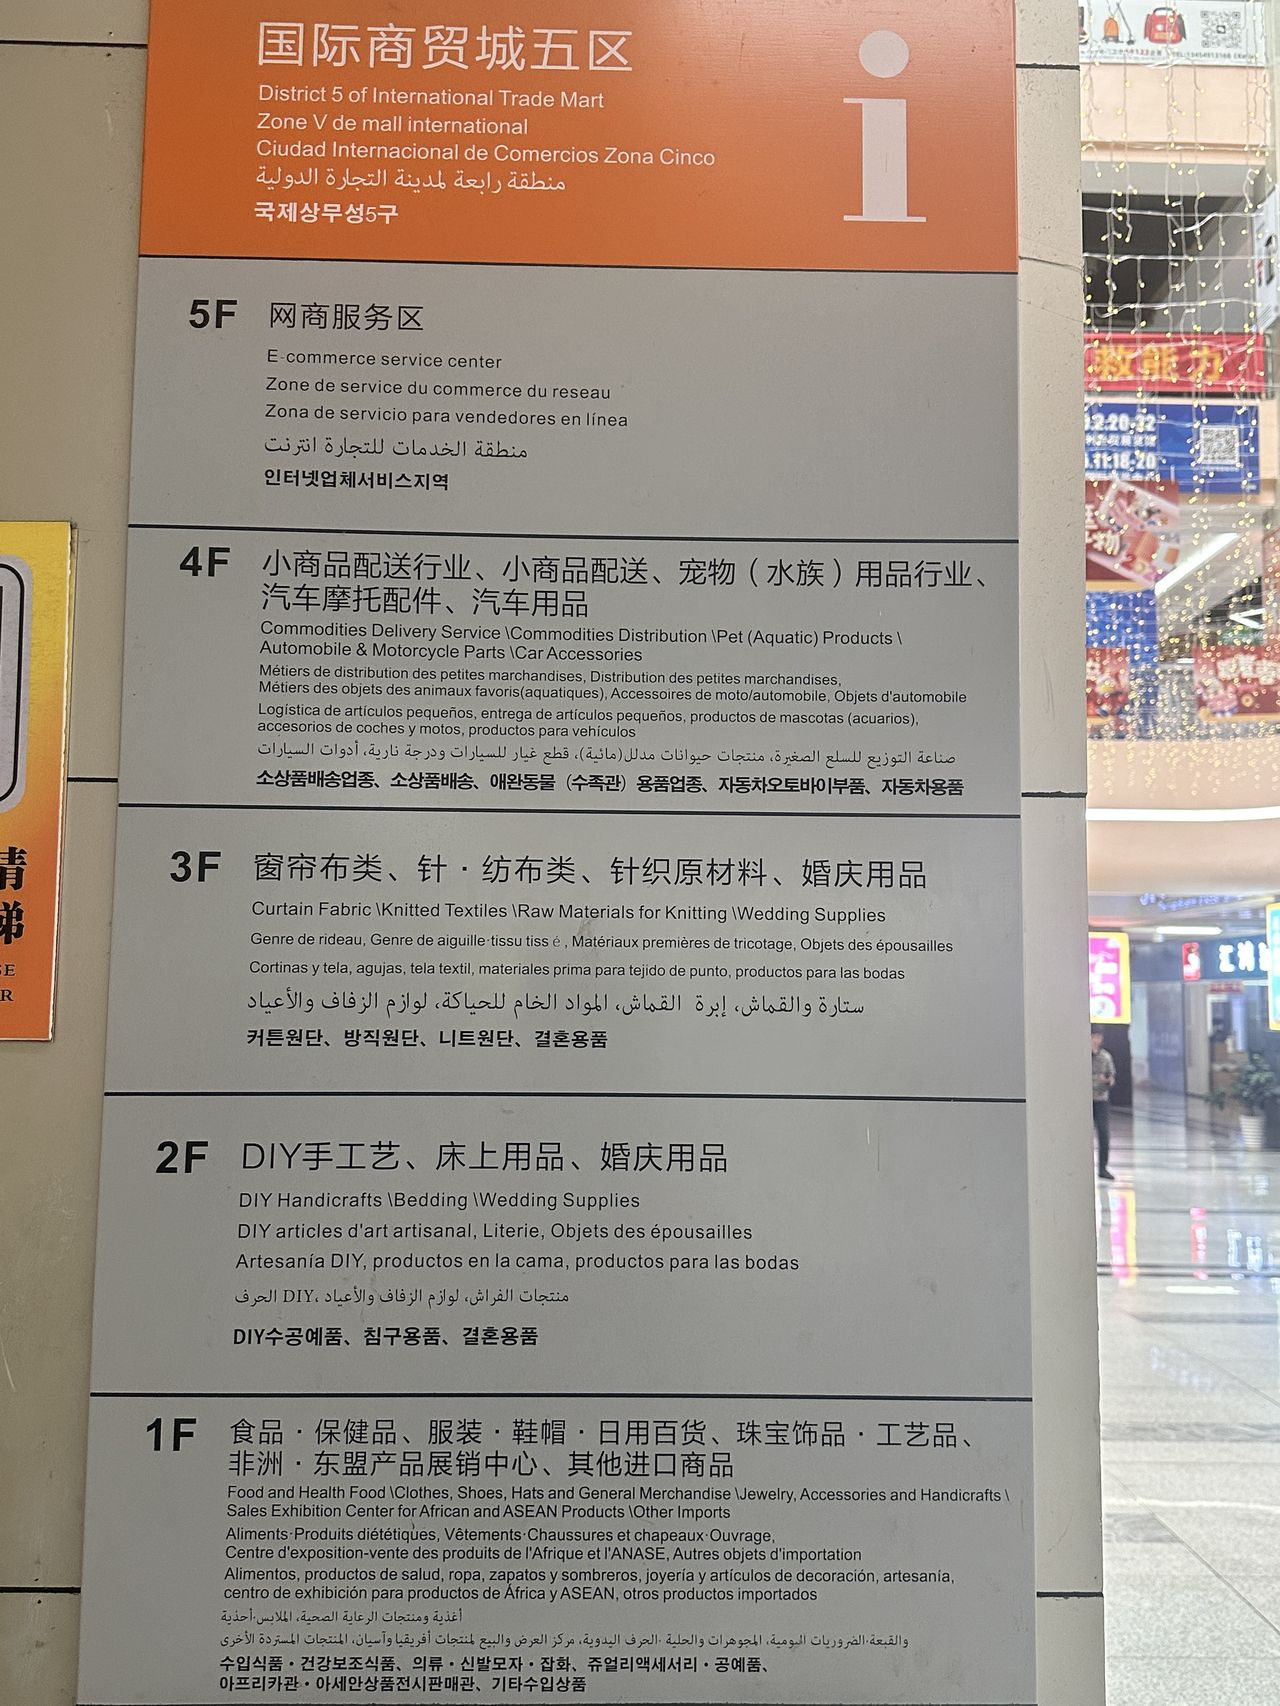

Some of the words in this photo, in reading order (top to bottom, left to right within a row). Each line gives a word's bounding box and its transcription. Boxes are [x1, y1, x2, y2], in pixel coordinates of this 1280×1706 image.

[257, 21, 633, 72] 国际商贸城五区
[258, 84, 327, 102] District
[331, 86, 344, 103] 5
[348, 86, 369, 103] of
[372, 86, 494, 106] International
[497, 89, 555, 108] Trade
[560, 91, 605, 109] Mart
[256, 112, 308, 130] Zone
[312, 113, 328, 131] V
[332, 114, 357, 131] de
[362, 115, 402, 132] mall
[408, 115, 528, 135] international
[256, 139, 326, 158] Ciudad
[332, 140, 459, 161] Internacional
[463, 144, 489, 161] de
[493, 144, 599, 164] Comercios
[603, 146, 654, 165] Zona
[659, 147, 716, 166] Cinco
[255, 165, 318, 191] الدولية
[325, 167, 387, 192] التجارة
[394, 168, 447, 194] لمدينة
[453, 169, 502, 196] رابعة
[507, 170, 566, 191] منطقة
[253, 201, 399, 225] 국제상무성5구
[188, 299, 238, 329] 5F
[269, 301, 424, 331] 网商服务区
[380, 352, 443, 368] service
[447, 355, 503, 369] center
[265, 376, 310, 392] Zone
[314, 377, 336, 393] de
[340, 379, 403, 395] service
[407, 380, 428, 395] du
[432, 384, 523, 398] commerce
[526, 383, 547, 399] du
[552, 387, 611, 400] reseau
[264, 403, 309, 419] Zona
[313, 405, 335, 420] de
[339, 406, 407, 422] servicio
[412, 411, 450, 424] para
[455, 409, 556, 426] vendedores
[560, 414, 581, 426] en
[586, 411, 628, 427] línea
[264, 436, 317, 457] انترنت
[324, 436, 385, 459] للتجارة
[392, 438, 466, 457] الخدمات
[474, 440, 528, 459] منطقة
[264, 468, 449, 492] 인터넷업체서비스지역
[179, 546, 231, 578] 4F
[261, 582, 588, 618] 汽车摩托配件、汽车用品
[260, 620, 367, 637] Commodities
[371, 623, 437, 642] Delivery
[441, 624, 501, 640] Service
[618, 627, 707, 644] Distribution
[747, 629, 819, 648] (Aquatic)
[823, 630, 893, 646] Products
[259, 639, 352, 657] Automobile
[355, 642, 368, 657] &
[372, 642, 460, 662] Motorcycle
[464, 644, 506, 660] Parts
[546, 646, 643, 662] Accessories
[259, 663, 311, 679] Métiers
[313, 665, 331, 678] de
[333, 665, 409, 680] distribution
[412, 667, 437, 680] des
[440, 668, 486, 683] petites
[488, 669, 587, 684] marchandises,
[590, 670, 666, 684] Distribution
[668, 671, 694, 684] des
[696, 672, 741, 687] petites
[744, 673, 842, 688] marchandises,
[169, 850, 222, 883] 3F
[251, 900, 314, 916] Curtain
[318, 901, 372, 917] Fabric
[444, 902, 508, 918] Textiles
[559, 904, 635, 920] Materials
[638, 904, 662, 920] for
[665, 905, 727, 924] Knitting
[814, 907, 886, 926] Supplies
[249, 960, 309, 974] Cortinas
[311, 964, 321, 977] y
[322, 961, 353, 976] tela,
[356, 961, 406, 977] agujas,
[409, 962, 435, 975] tela
[438, 962, 475, 977] textil,
[478, 962, 550, 976] materiales
[553, 965, 592, 979] prima
[595, 966, 626, 979] para
[628, 963, 666, 980] tejido
[668, 964, 686, 977] de
[689, 965, 732, 980] punto,
[735, 965, 803, 981] productos
[806, 968, 837, 982] para
[840, 966, 860, 979] las
[863, 966, 906, 980] bodas
[155, 1140, 209, 1174] 2F
[239, 1192, 273, 1208] DIY
[277, 1191, 383, 1208] Handicrafts
[562, 1191, 640, 1212] Supplies
[237, 1223, 272, 1239] DIY
[275, 1222, 343, 1239] articles
[347, 1222, 389, 1239] d'art
[392, 1222, 477, 1241] artisanal,
[483, 1222, 545, 1241] Literie,
[550, 1222, 609, 1242] Objets
[613, 1223, 646, 1239] des
[650, 1223, 753, 1243] épousailles
[235, 1252, 325, 1269] Artesanía
[330, 1252, 367, 1271] DIY,
[372, 1252, 463, 1272] productos
[468, 1256, 490, 1269] en
[495, 1252, 510, 1268] la
[515, 1256, 570, 1271] cama,
[575, 1252, 665, 1272] productos
[669, 1257, 709, 1273] para
[714, 1253, 740, 1270] las
[745, 1254, 800, 1271] bodas
[462, 1326, 539, 1346] 결혼용품
[146, 1417, 197, 1452] 1F
[226, 1503, 268, 1518] Sales
[271, 1503, 342, 1518] Exhibition
[345, 1503, 395, 1518] Center
[396, 1503, 418, 1519] for
[420, 1503, 472, 1519] African
[473, 1504, 501, 1518] and
[502, 1504, 558, 1518] ASEAN
[561, 1504, 625, 1519] Products
[677, 1505, 731, 1522] Imports
